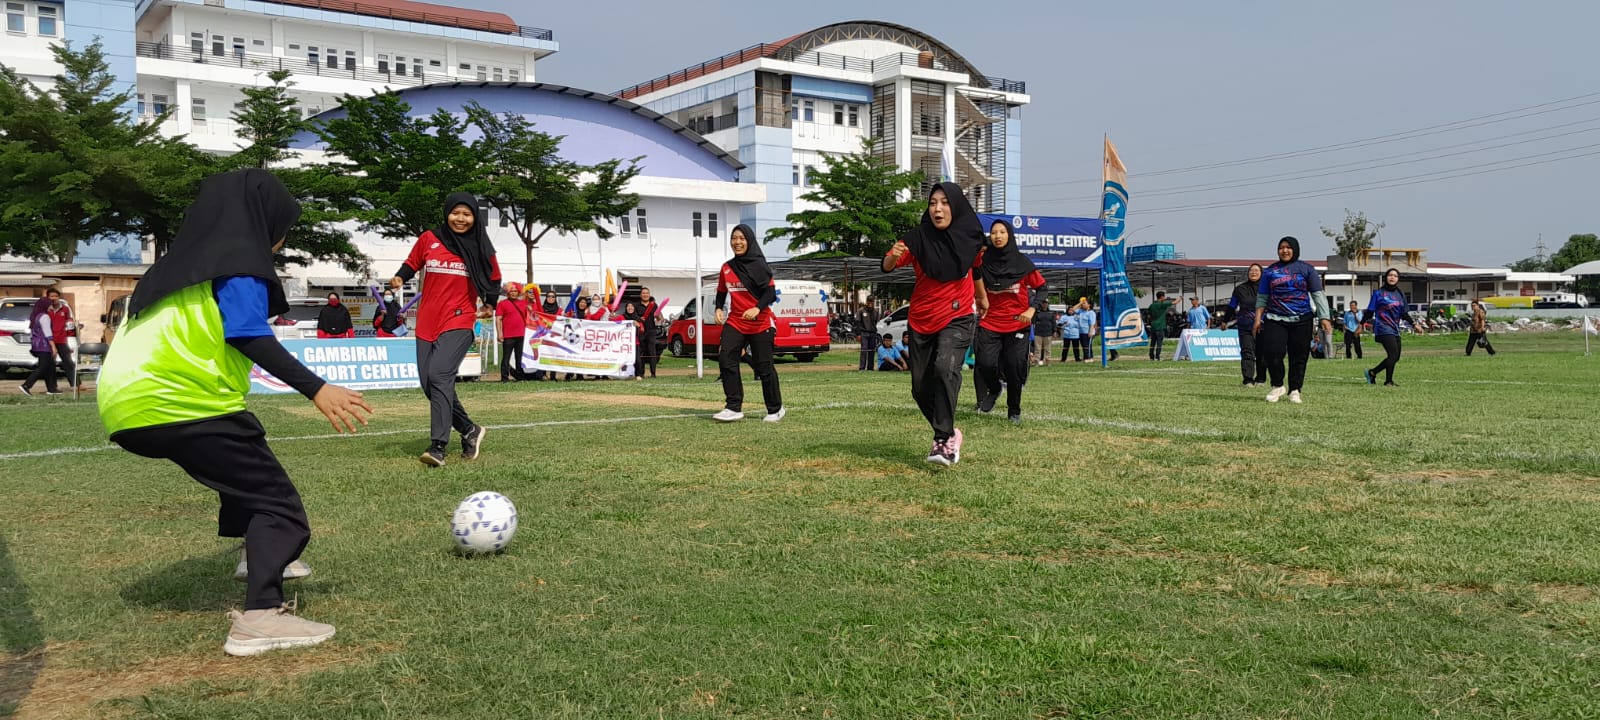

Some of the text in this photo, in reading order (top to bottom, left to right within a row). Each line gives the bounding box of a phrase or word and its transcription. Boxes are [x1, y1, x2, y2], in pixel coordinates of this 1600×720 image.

[1014, 233, 1098, 249] SPORTS CENTRE
[584, 328, 632, 343] BAWA
[304, 345, 388, 363] GAMBIRAN
[582, 341, 632, 354] PIALA!
[307, 362, 419, 382] SPORT CENTER
